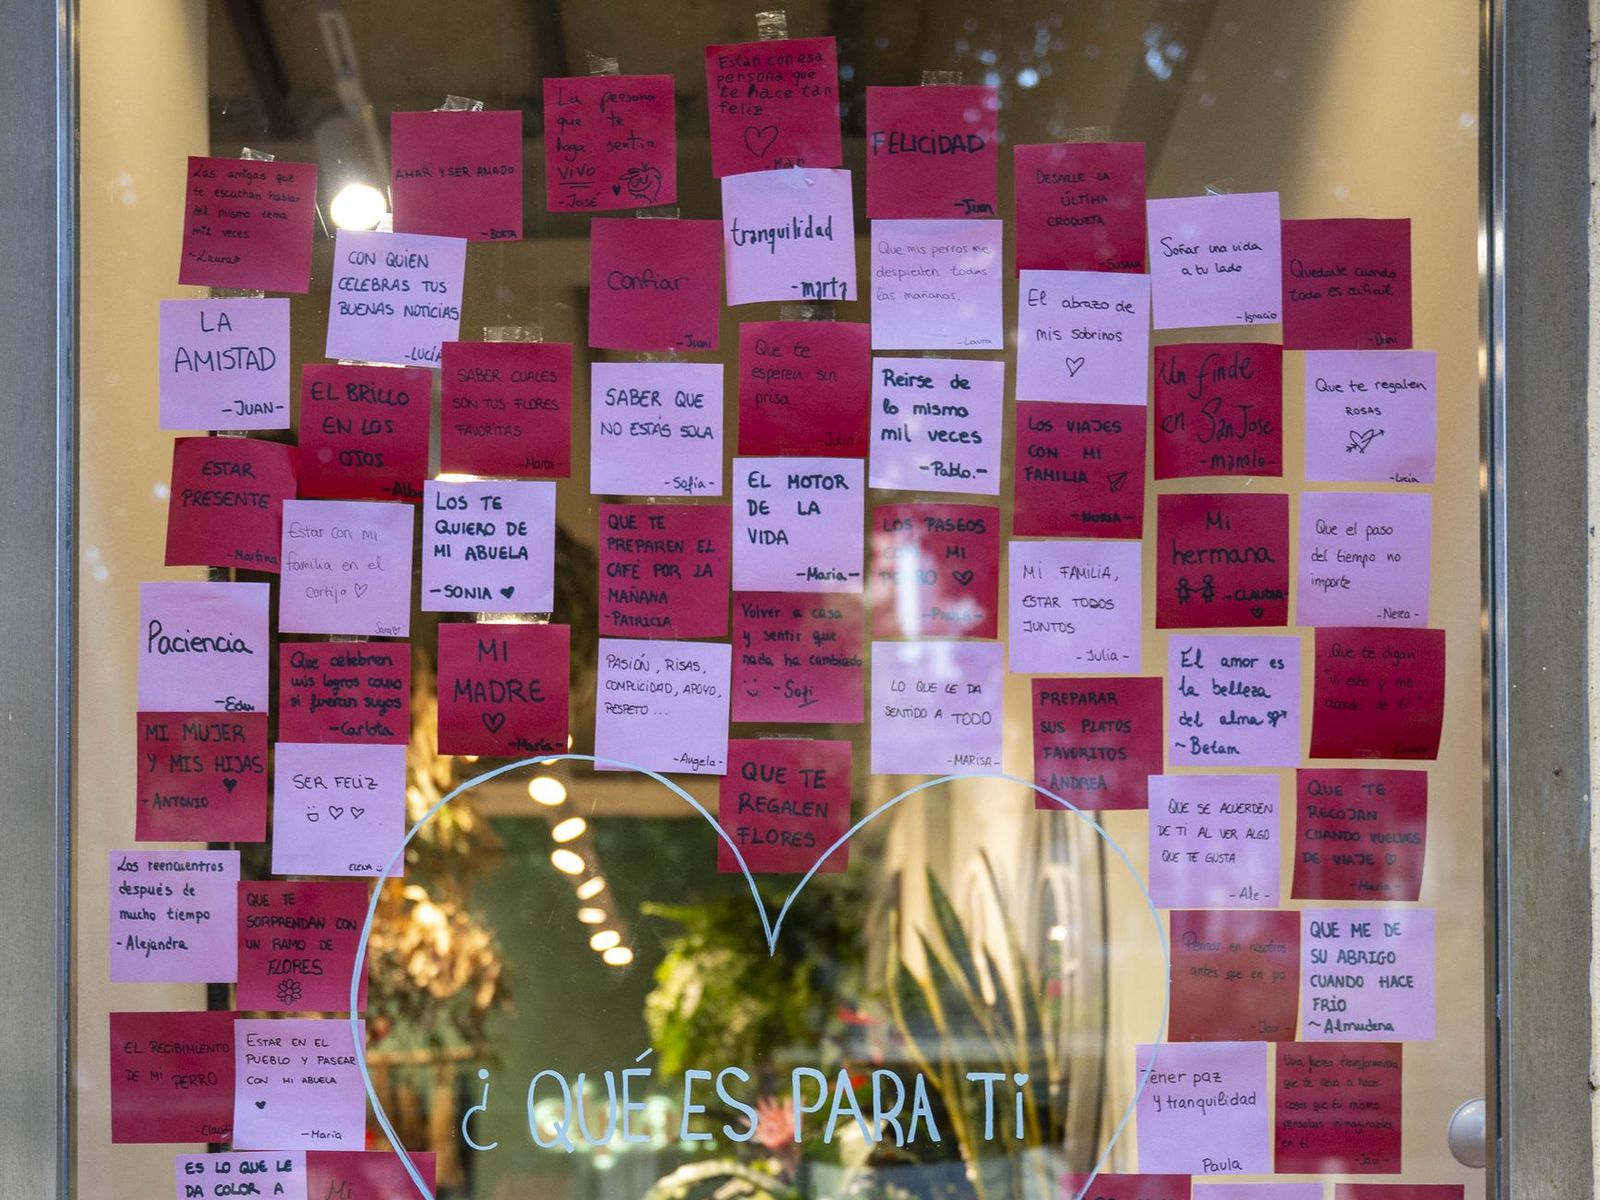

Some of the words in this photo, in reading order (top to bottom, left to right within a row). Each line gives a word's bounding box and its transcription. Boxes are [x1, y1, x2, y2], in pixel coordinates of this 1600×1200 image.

[730, 214, 833, 255] tranquilidad
[1159, 235, 1200, 258] Soñar
[1208, 244, 1229, 254] una
[1232, 241, 1264, 253] vida
[347, 250, 377, 266] CON
[1181, 267, 1193, 277] a
[1194, 264, 1209, 276] tu
[1214, 262, 1243, 274] lado
[338, 276, 411, 293] CELEBRAS
[420, 280, 448, 294] TUS
[337, 300, 395, 317] BUENAS
[1027, 288, 1048, 307] El
[1061, 295, 1110, 310] abrazo
[1115, 300, 1136, 315] de
[200, 311, 233, 333] LA
[1035, 328, 1063, 342] mis
[1071, 326, 1123, 343] sobrinos
[174, 346, 277, 373] AMISTAD
[881, 368, 935, 390] Reirse
[949, 373, 972, 391] de
[1314, 377, 1345, 393] Que
[1348, 379, 1369, 393] te
[1374, 378, 1428, 394] regalen
[310, 381, 340, 401] EL
[604, 387, 663, 408] SABER
[674, 390, 705, 409] QUE
[882, 397, 900, 416] lo
[912, 402, 970, 419] mismo
[1344, 406, 1382, 417] ROSAS
[322, 415, 352, 435] EN
[361, 417, 394, 436] LOS
[600, 421, 623, 437] NO
[629, 415, 672, 438] ESTÁS
[679, 424, 714, 440] SOLA
[880, 424, 913, 443] mil
[927, 429, 983, 445] veces
[337, 447, 389, 469] OJOS
[201, 460, 256, 480] ESTAR
[747, 470, 772, 489] EL
[787, 473, 849, 491] MOTOR
[180, 488, 272, 510] PRESENTE
[435, 491, 468, 511] LOS
[479, 495, 503, 511] TE
[746, 498, 771, 517] DE
[797, 500, 822, 516] LA
[434, 519, 496, 537] QUIERO
[505, 521, 528, 537] DE
[607, 513, 638, 532] QUE
[647, 514, 666, 531] TE
[606, 536, 685, 555] PREPAREN
[696, 538, 716, 554] EL
[747, 527, 789, 546] VIDA
[433, 543, 452, 558] MI
[464, 544, 529, 562] ABUELA
[1171, 538, 1276, 566] hermana
[606, 558, 641, 580] CAFÉ
[652, 562, 682, 580] POR
[692, 562, 714, 578] LA
[607, 585, 669, 606] MAÑANA
[147, 619, 254, 656] Paciencia
[477, 637, 508, 663] MI
[1180, 646, 1205, 670] El
[1220, 656, 1260, 669] amor
[1269, 658, 1285, 670] es
[453, 678, 546, 705] MADRE
[1177, 675, 1200, 698] la
[1211, 677, 1272, 699] belleza
[1178, 710, 1204, 728] del
[1219, 709, 1265, 727] alma
[291, 773, 329, 790] SER
[740, 761, 788, 785] QUE
[798, 768, 827, 790] TE
[737, 791, 829, 819] REGALEN
[737, 826, 816, 849] FLORES
[116, 855, 139, 873] Los
[147, 860, 224, 873] reencuentros
[118, 879, 174, 900] después
[182, 882, 196, 897] de
[119, 907, 156, 922] mucho
[166, 907, 211, 925] tiempo
[1309, 920, 1341, 940] QUE
[1350, 921, 1372, 939] ME
[1383, 921, 1402, 938] DE
[1310, 948, 1328, 965] SU
[1336, 948, 1397, 966] ABRIGO
[1309, 973, 1365, 989] CUANDO
[1378, 974, 1414, 989] HACE
[681, 1067, 758, 1142] ES
[793, 1068, 941, 1148] PARA
[1201, 1157, 1243, 1174] Paula
